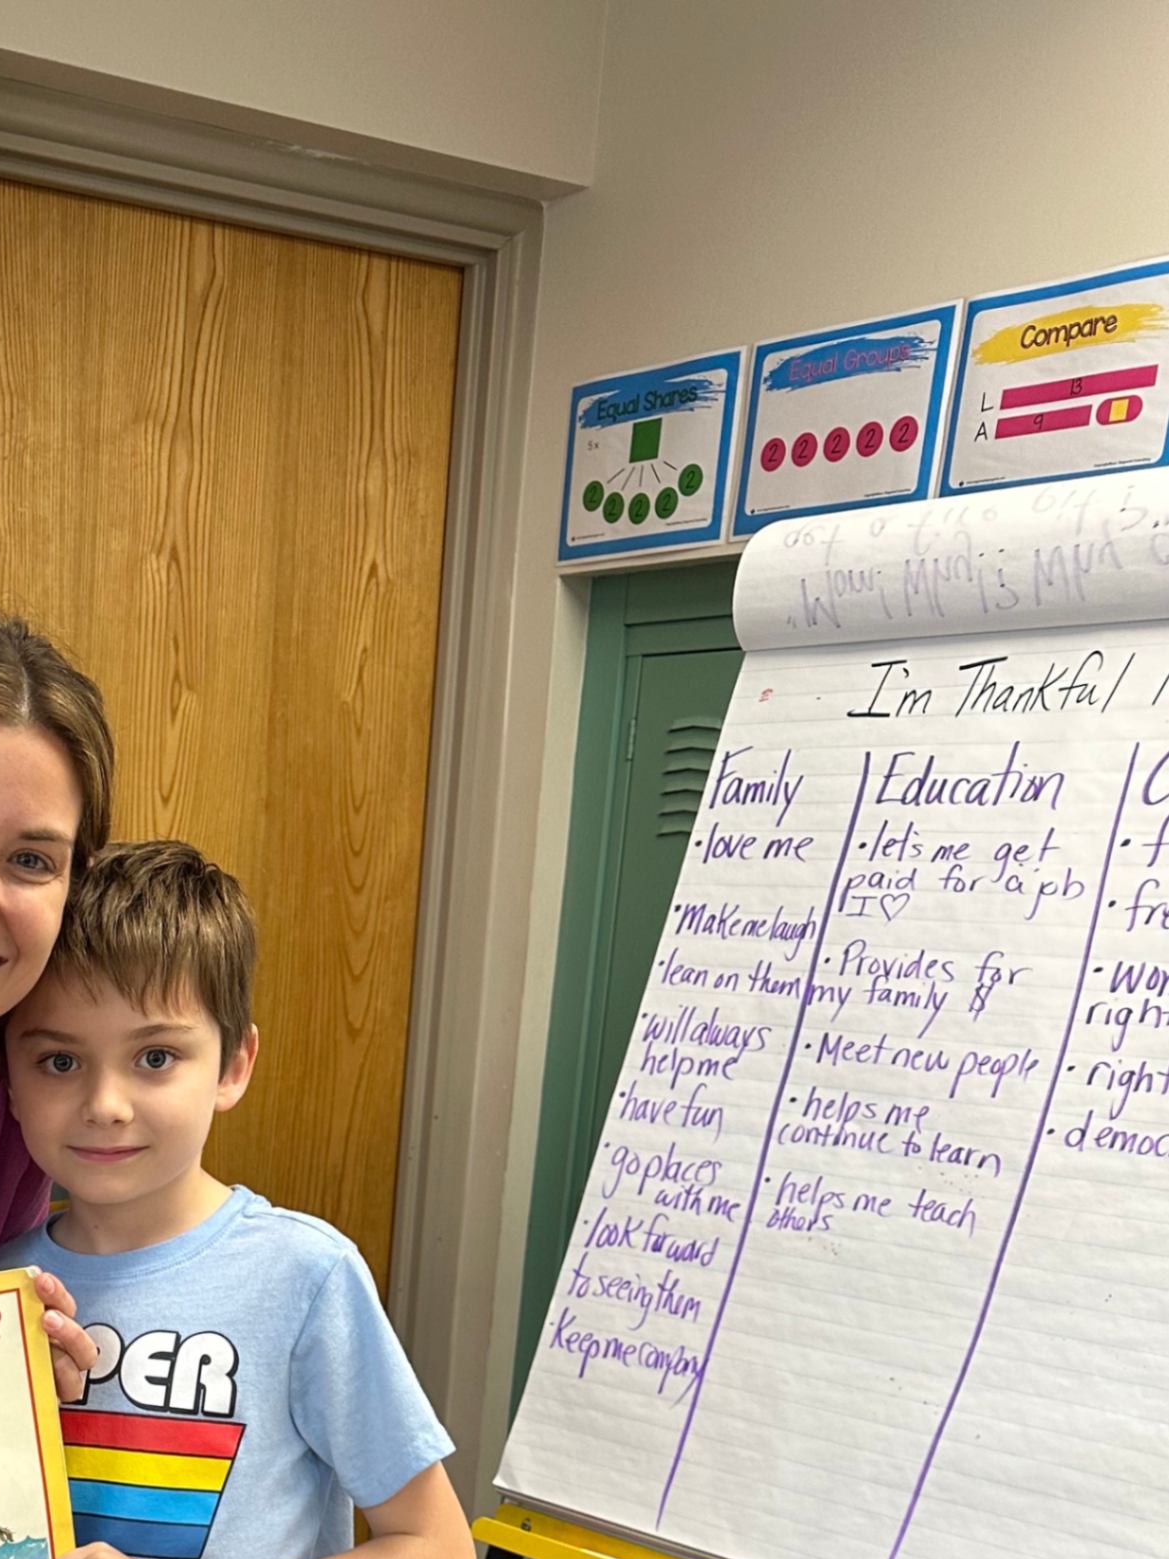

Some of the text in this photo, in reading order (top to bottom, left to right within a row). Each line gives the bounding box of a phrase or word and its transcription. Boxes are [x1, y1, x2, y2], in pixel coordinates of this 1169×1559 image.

[1020, 314, 1118, 349] Compare
[788, 344, 913, 384] Equal Groups
[596, 386, 698, 423] Equal Shares
[980, 391, 995, 413] L
[768, 422, 910, 464] 2 2 2 2 2
[973, 421, 989, 443] A
[587, 485, 672, 518] 2 2 2 2
[686, 469, 696, 490] 2
[846, 659, 933, 719] I'm
[708, 745, 804, 828] Family
[875, 740, 1066, 811] Education
[702, 821, 815, 865] love me
[931, 841, 971, 863] me
[993, 826, 1061, 884] get
[837, 867, 918, 914] paid
[937, 864, 986, 894] for
[1004, 873, 1026, 894] a
[768, 905, 818, 962] laugh
[663, 946, 801, 1001] lean on them
[838, 938, 1035, 986] Provides for
[644, 1003, 773, 1062] will always
[808, 984, 852, 1023] my
[862, 974, 950, 1040] family
[639, 1048, 737, 1090] help me
[815, 1032, 1041, 1100] Meet new people
[622, 1079, 724, 1145] have fun
[802, 1085, 931, 1134] helps me
[1063, 1109, 1169, 1158] democ
[603, 1141, 723, 1200] go places
[777, 1120, 1003, 1179] continue to learn
[653, 1184, 743, 1223] with me
[765, 1206, 835, 1234] others
[775, 1170, 977, 1239] helps me teach
[586, 1205, 720, 1268] look forward
[567, 1251, 590, 1299] to
[592, 1272, 654, 1331] seeing
[63, 1322, 240, 1418] PER
